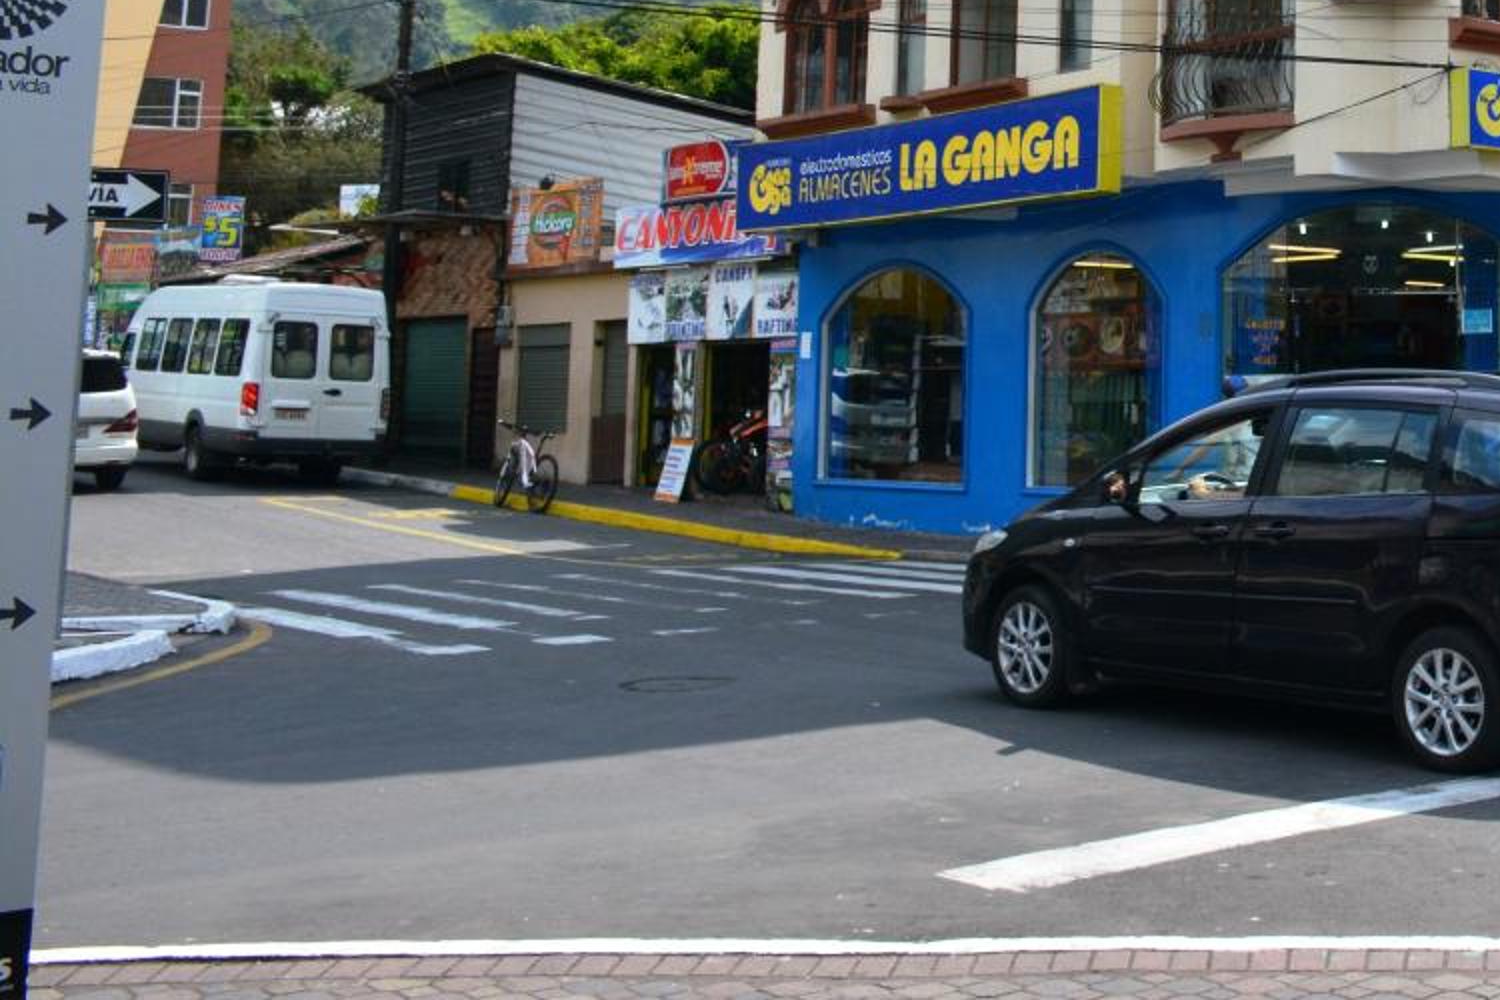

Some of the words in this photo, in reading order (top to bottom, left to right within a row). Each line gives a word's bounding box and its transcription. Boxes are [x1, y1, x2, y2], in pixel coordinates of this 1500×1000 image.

[9, 78, 51, 95] vida
[899, 138, 937, 192] LA
[942, 115, 1080, 184] GANGA
[799, 165, 891, 204] ALMACENES
